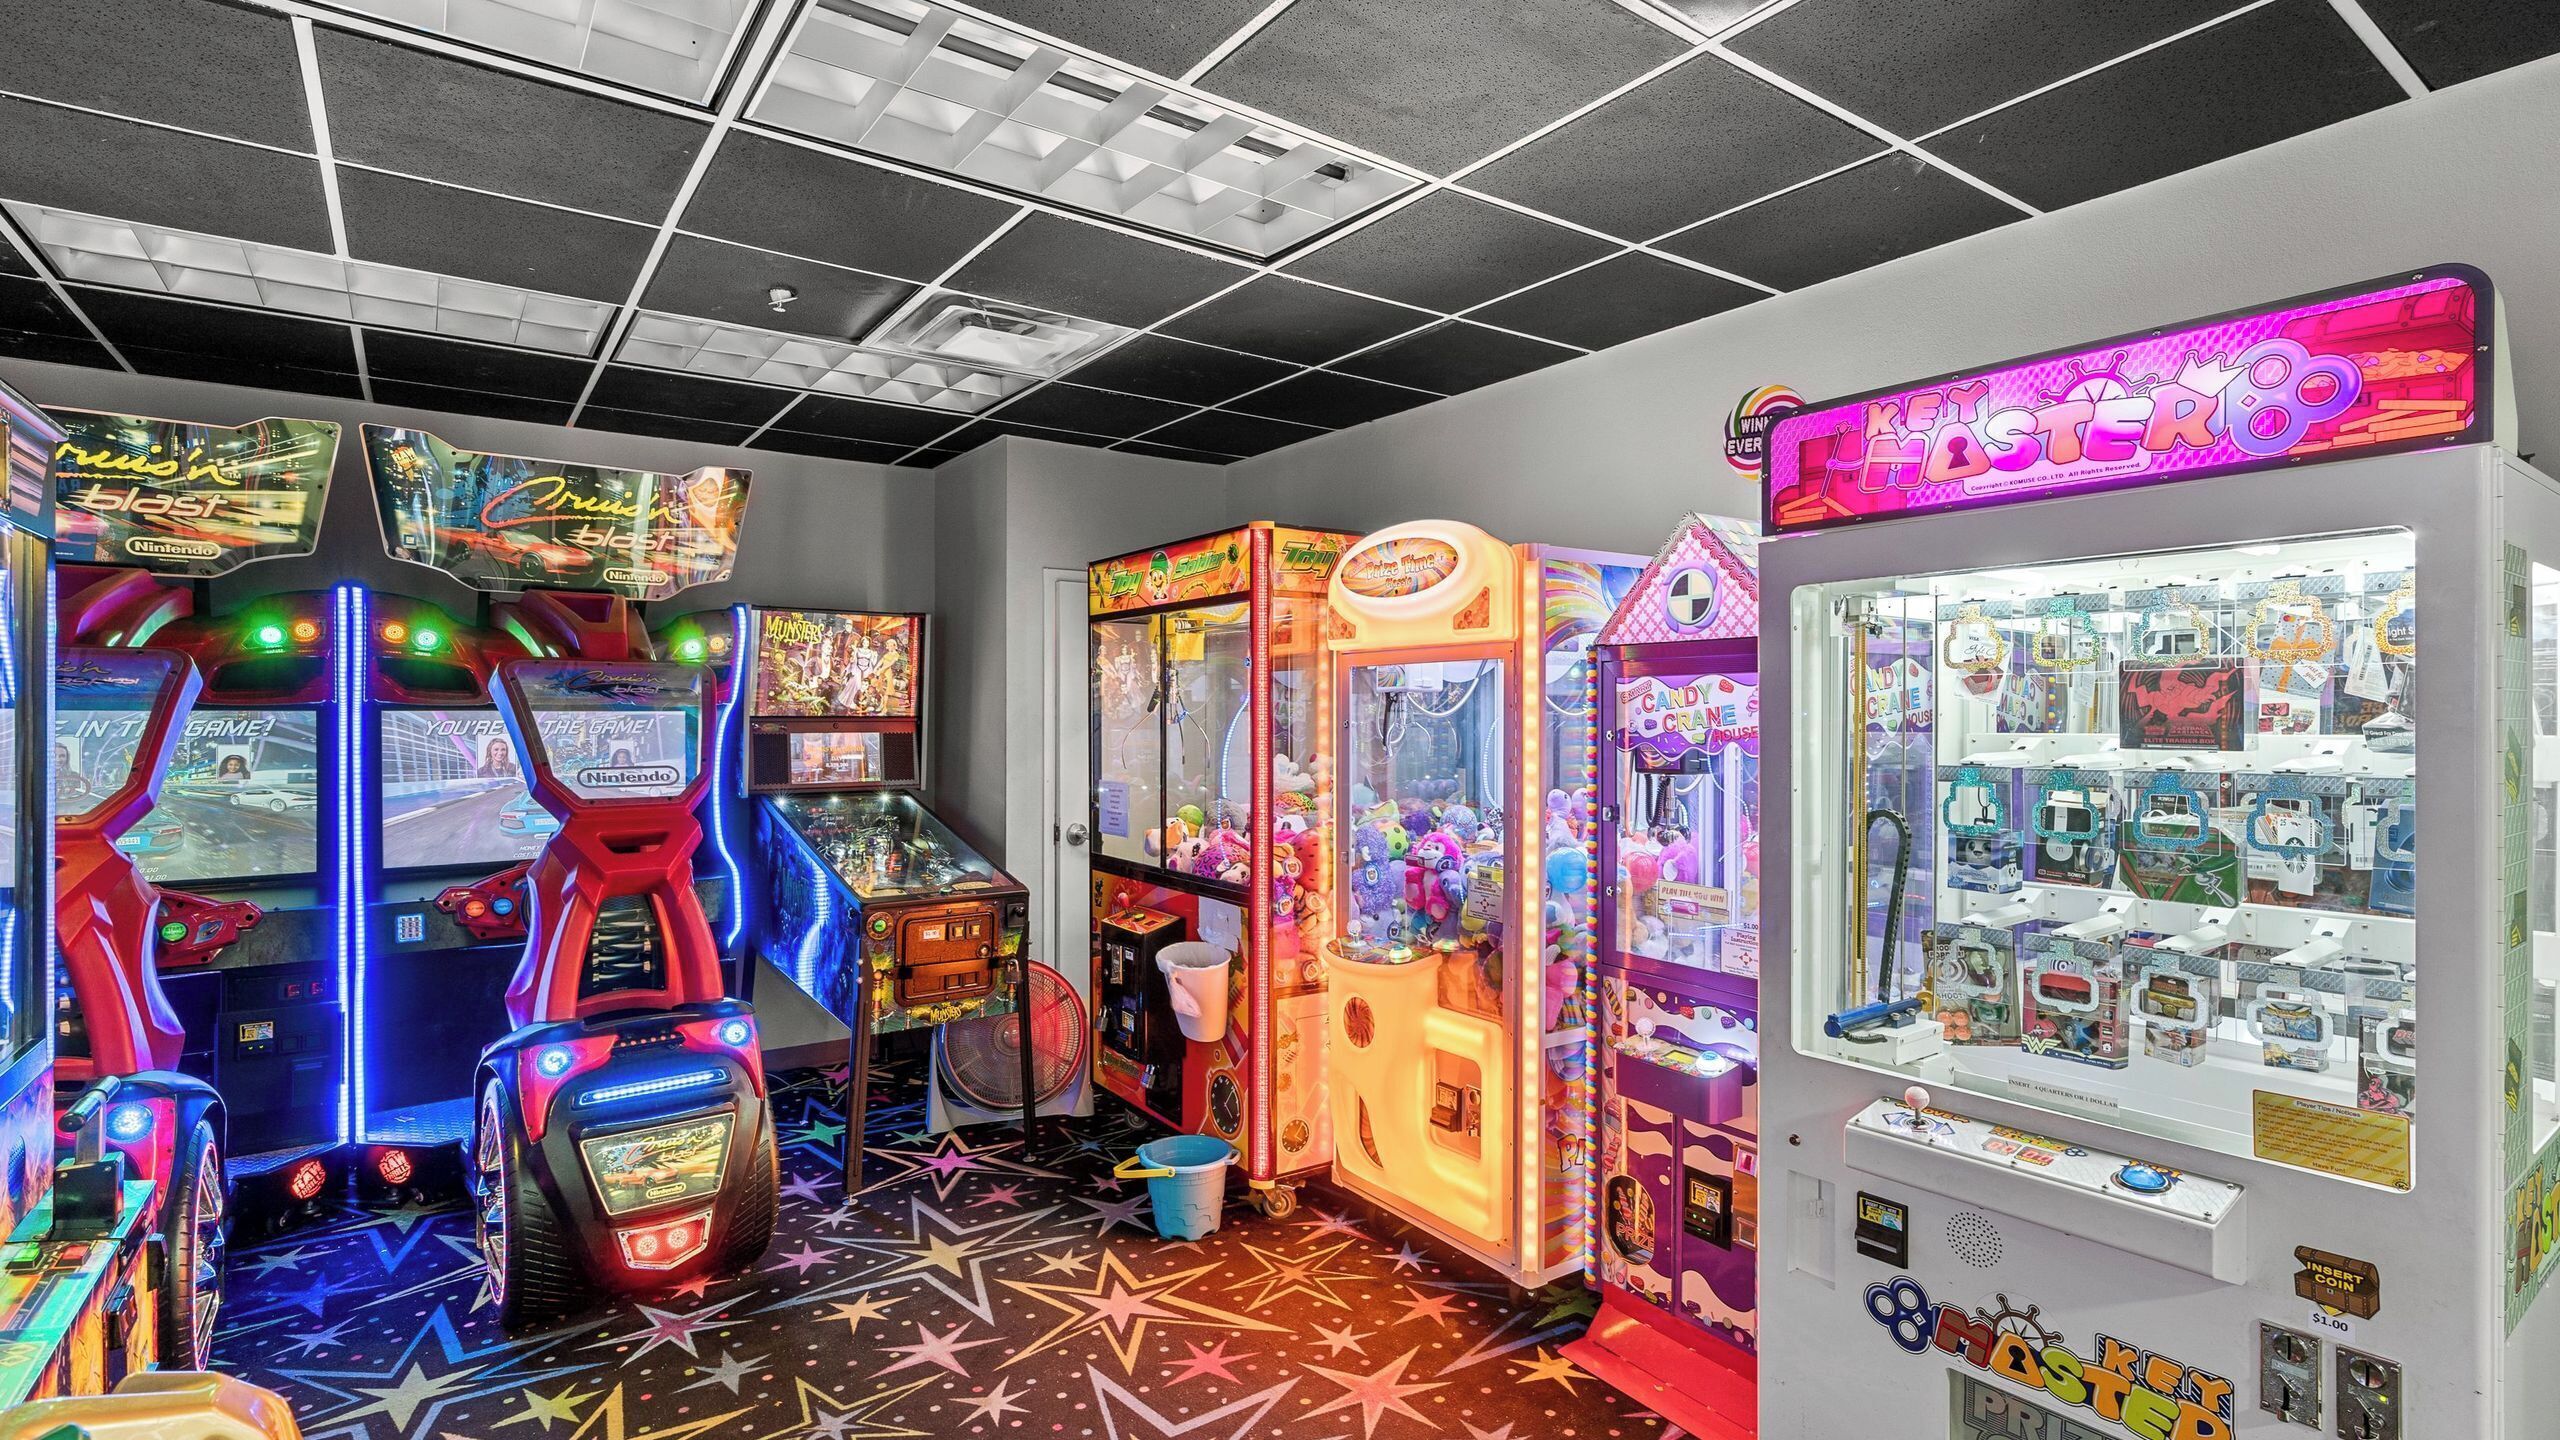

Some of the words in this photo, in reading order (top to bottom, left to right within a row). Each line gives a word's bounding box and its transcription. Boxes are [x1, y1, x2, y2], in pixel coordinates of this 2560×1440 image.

[1865, 382, 1988, 440] KEY
[1727, 437, 1762, 455] EVER
[1860, 386, 2219, 491] MASTER
[56, 442, 241, 486] ruis'n
[1971, 482, 2002, 492] Copyright
[2009, 477, 2036, 486] KOMUSE
[2068, 470, 2079, 478] All
[2080, 468, 2103, 476] Rights
[2104, 462, 2142, 472] Reserved.
[82, 484, 229, 518] blast
[133, 540, 214, 557] Nintendo
[571, 524, 677, 552] blast
[1171, 550, 1227, 582] Soldier
[1277, 540, 1341, 581] Toy
[1365, 560, 1399, 581] Prize
[1401, 553, 1435, 575] Time
[608, 568, 665, 584] Nintendo
[1109, 570, 1144, 599] Toy
[1385, 576, 1413, 588] Classic
[766, 615, 825, 644] MUNSTERS
[612, 684, 664, 695] blast
[1641, 683, 1714, 714] CANDY
[75, 719, 111, 737] IN
[184, 718, 276, 738] GAME!
[426, 719, 505, 736] YOU'RE
[542, 718, 585, 735] THE
[587, 717, 655, 735] GAME!
[1662, 704, 1737, 733] CRANE
[1712, 725, 1759, 743] HOUSE
[2164, 737, 2198, 745] TRAINER
[586, 770, 672, 785] Nintendo
[1661, 886, 1678, 896] PLAY
[1680, 888, 1692, 897] TILL
[1710, 893, 1725, 903] WIN
[1735, 931, 1757, 941] Playing
[2008, 1079, 2031, 1089] INSERT
[2038, 1085, 2074, 1098] QUARTERS
[2090, 1097, 2119, 1109] DOLLAR
[2296, 1100, 2317, 1111] Player
[2318, 1104, 2331, 1113] Tips
[2335, 1107, 2362, 1118] Notices
[379, 1151, 407, 1175] RAW
[660, 1145, 701, 1161] blast
[292, 1160, 323, 1194] RAW
[649, 1184, 684, 1197] Nintendo
[1615, 1221, 1655, 1252] PRIZE
[2305, 1260, 2365, 1285] INSERT
[2314, 1273, 2355, 1293] COIN
[2311, 1312, 2349, 1332] $1.00
[1933, 1307, 2235, 1440] MASTER
[2102, 1337, 2232, 1412] KEY
